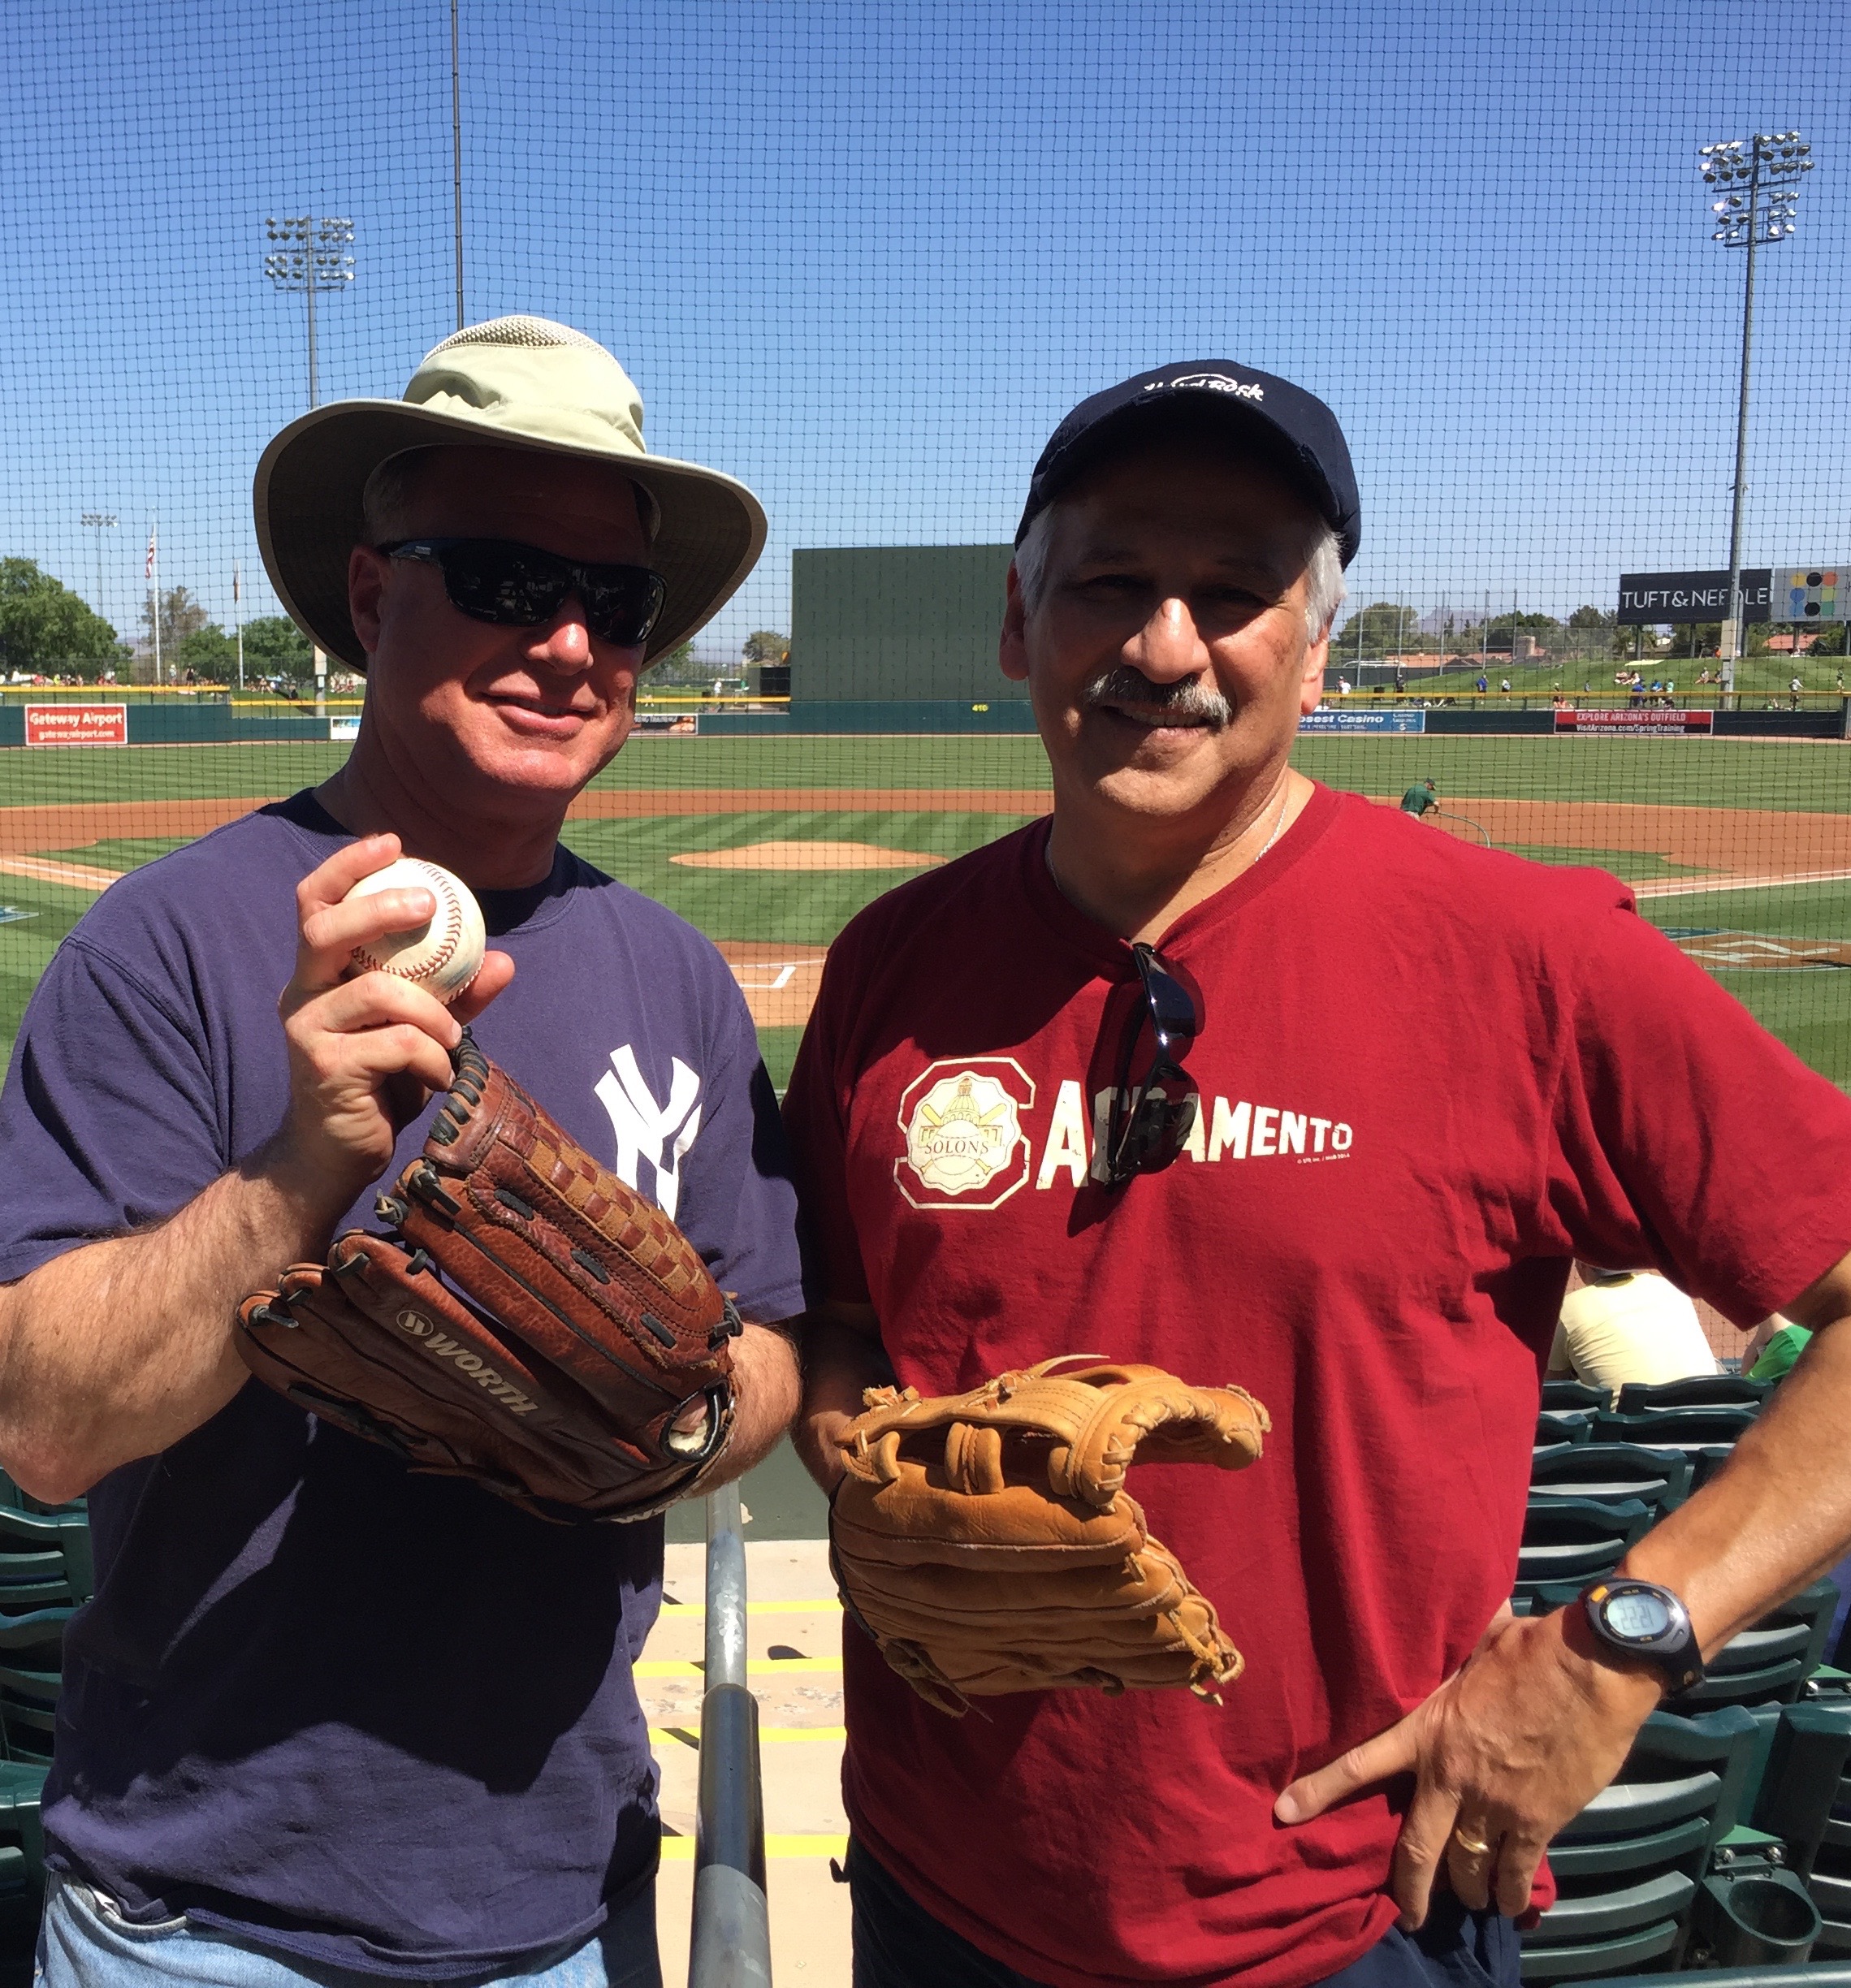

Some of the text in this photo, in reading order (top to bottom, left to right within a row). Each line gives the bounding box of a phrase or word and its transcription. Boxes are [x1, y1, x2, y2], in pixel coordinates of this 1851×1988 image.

[1207, 379, 1265, 402] Rock
[29, 711, 123, 728] Gateway Airport
[1337, 714, 1385, 724] Casino
[1576, 712, 1687, 722] EXPLORE ARIZONA'S OUTFIELD
[38, 729, 115, 741] gatewayairport.com
[594, 1043, 703, 1223] NY
[893, 1057, 1354, 1210] SACAMENTO
[924, 1139, 989, 1155] SOLONS
[423, 1332, 539, 1417] WORTH
